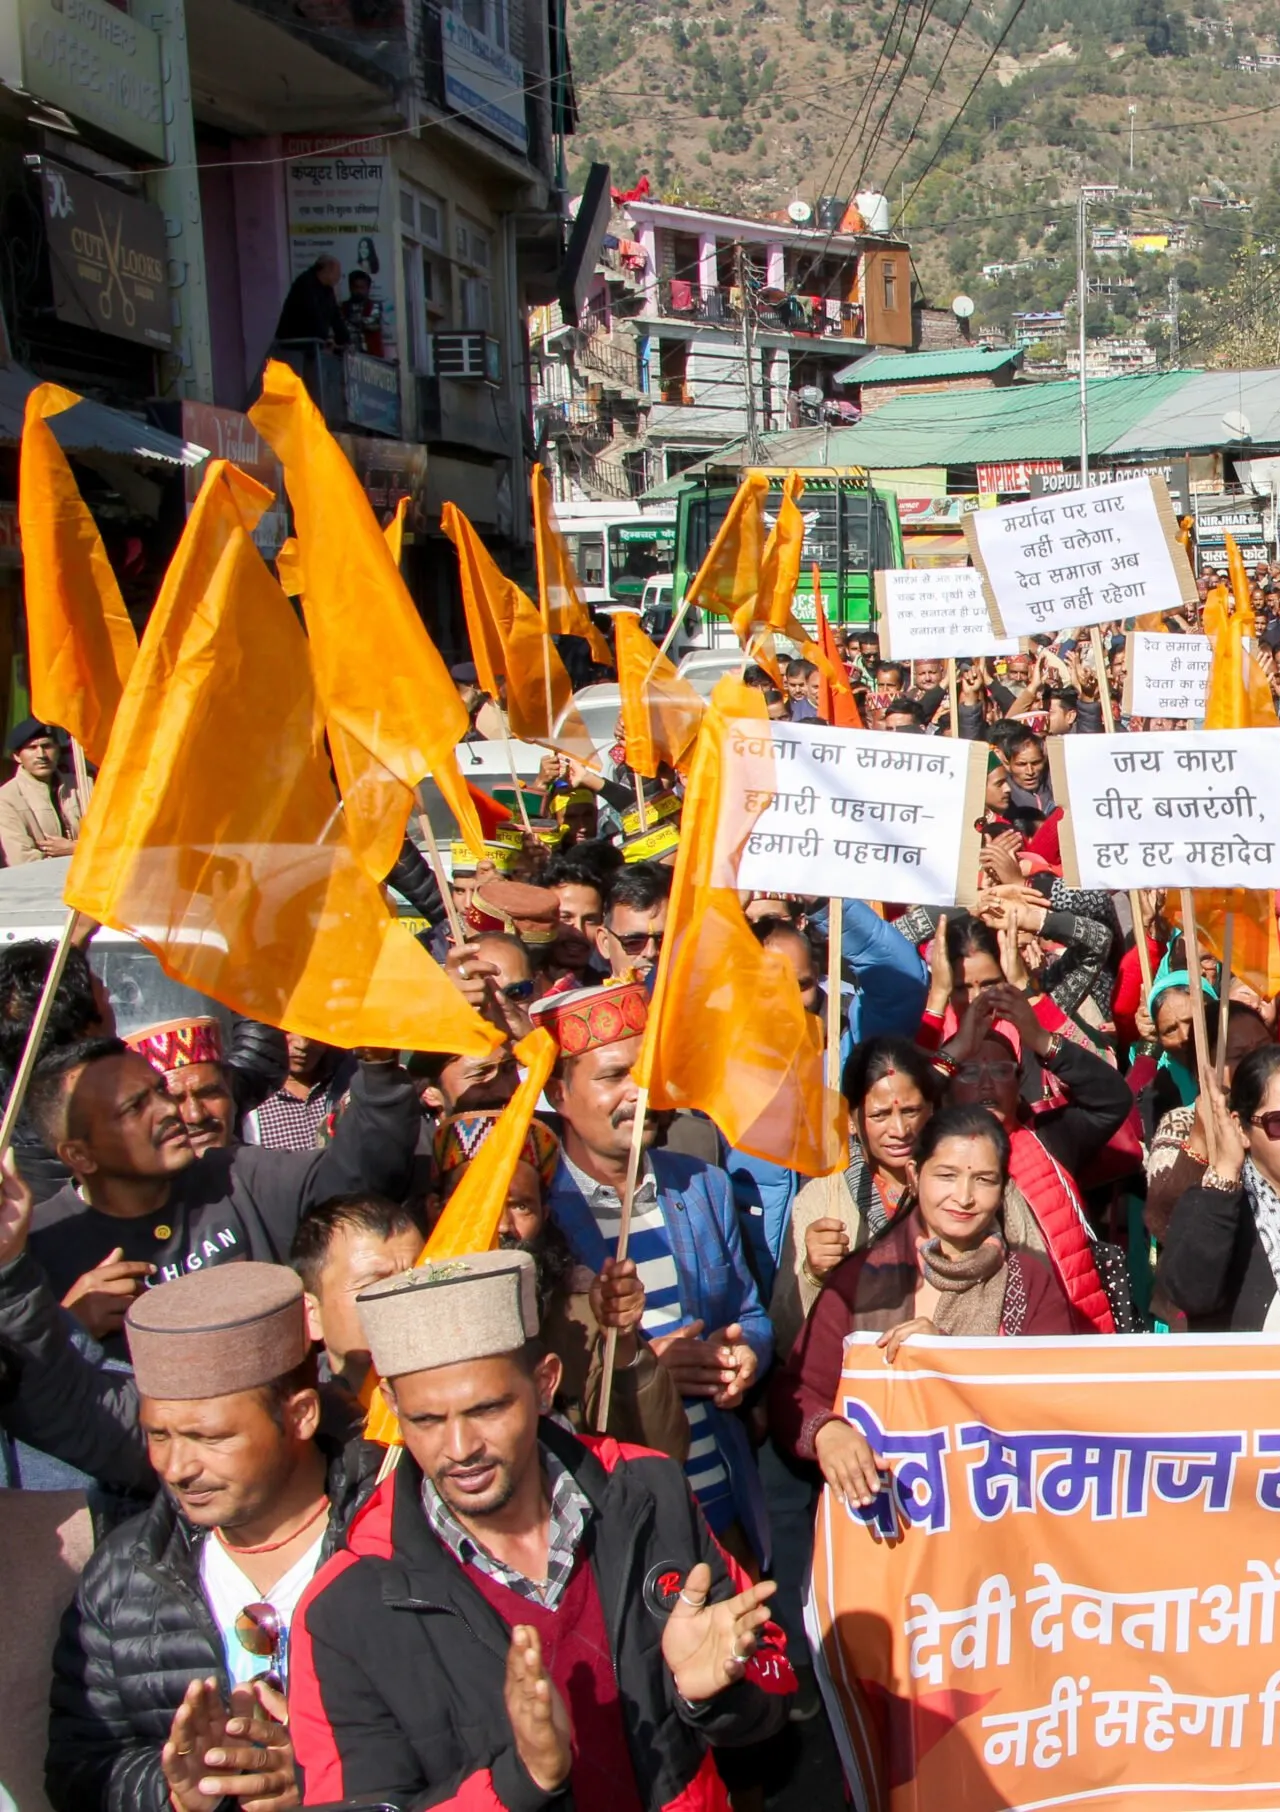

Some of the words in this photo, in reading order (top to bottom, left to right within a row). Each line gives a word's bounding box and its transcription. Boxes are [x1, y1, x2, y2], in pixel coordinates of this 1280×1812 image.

[71, 226, 104, 261] CUT
[121, 245, 163, 283] LOOKS
[978, 463, 1021, 493] EMPIRE
[1042, 472, 1097, 492] POPULR
[1002, 506, 1055, 533] मर्यादा
[1061, 503, 1088, 520] पर
[1092, 496, 1125, 514] वार
[1200, 515, 1247, 526] NIRJHAR
[1020, 534, 1054, 558] नहीं
[1060, 528, 1121, 550] चलेगा,
[1014, 570, 1042, 590] देव
[1048, 560, 1102, 584] समाज
[1111, 552, 1140, 571] अब
[960, 605, 969, 617] ही
[1025, 598, 1055, 623] चुप
[1061, 586, 1094, 610] नहीं
[1100, 581, 1147, 605] रहेगा
[949, 622, 959, 635] ही
[1144, 638, 1161, 651] देव
[1166, 641, 1201, 652] समाज
[1170, 656, 1181, 671] ही
[1145, 676, 1174, 689] देवता
[1180, 679, 1193, 689] का
[1159, 695, 1190, 708] सबसे
[732, 728, 801, 761] देवता
[811, 742, 846, 765] का
[856, 746, 955, 780] सम्मान,
[1111, 750, 1164, 774] जय
[1173, 749, 1237, 773] कारा
[744, 785, 821, 816] हमारी
[1093, 787, 1143, 821] वीर
[1152, 786, 1265, 823] बजरंगी,
[747, 828, 825, 858] हमारी
[833, 839, 927, 867] पहचान
[1093, 843, 1129, 868] हर
[1139, 842, 1174, 867] हर
[1184, 833, 1275, 867] महादेव
[844, 1396, 950, 1536] देव
[957, 1421, 1246, 1522] समाज
[904, 1574, 1015, 1685] देवी
[980, 1675, 1092, 1769] नहीं
[1094, 1674, 1249, 1753] सहेगा
